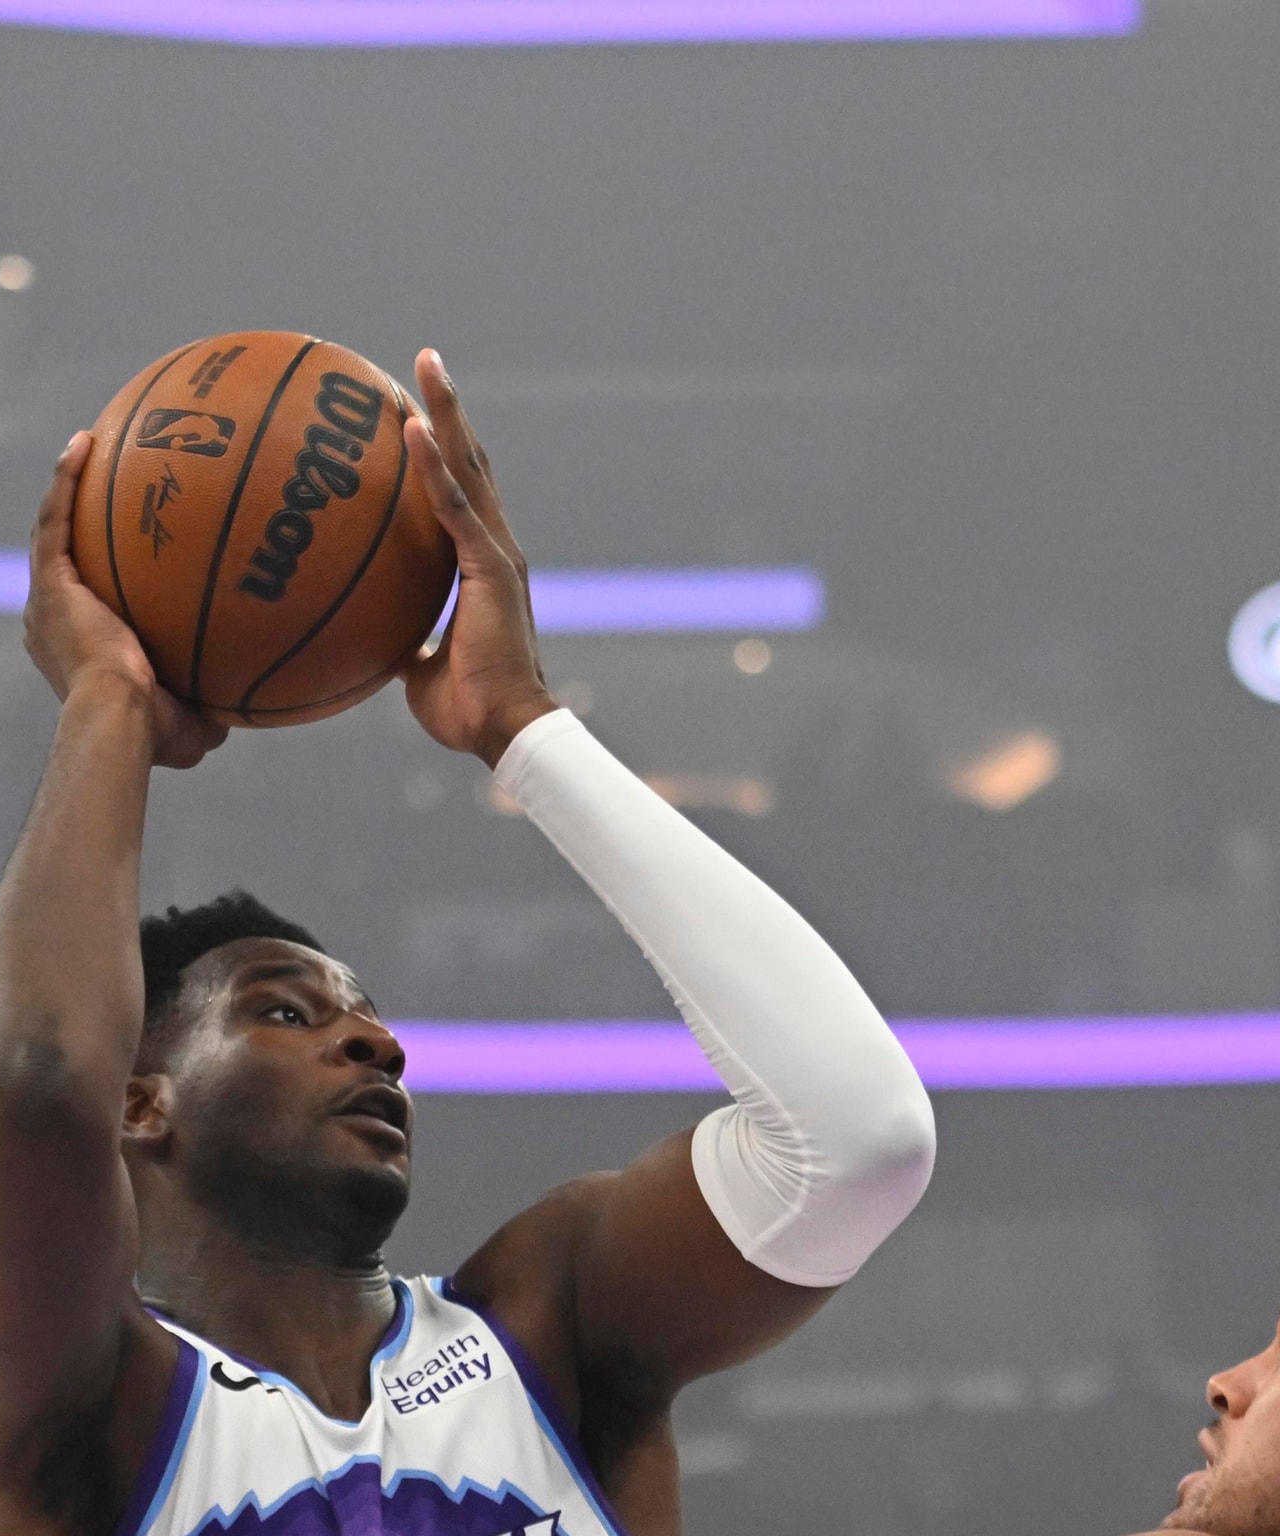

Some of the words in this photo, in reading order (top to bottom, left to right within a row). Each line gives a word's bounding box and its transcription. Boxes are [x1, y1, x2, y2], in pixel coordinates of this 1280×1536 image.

[237, 371, 385, 601] Wilson
[380, 1334, 480, 1396] Health
[390, 1352, 492, 1415] Equity
